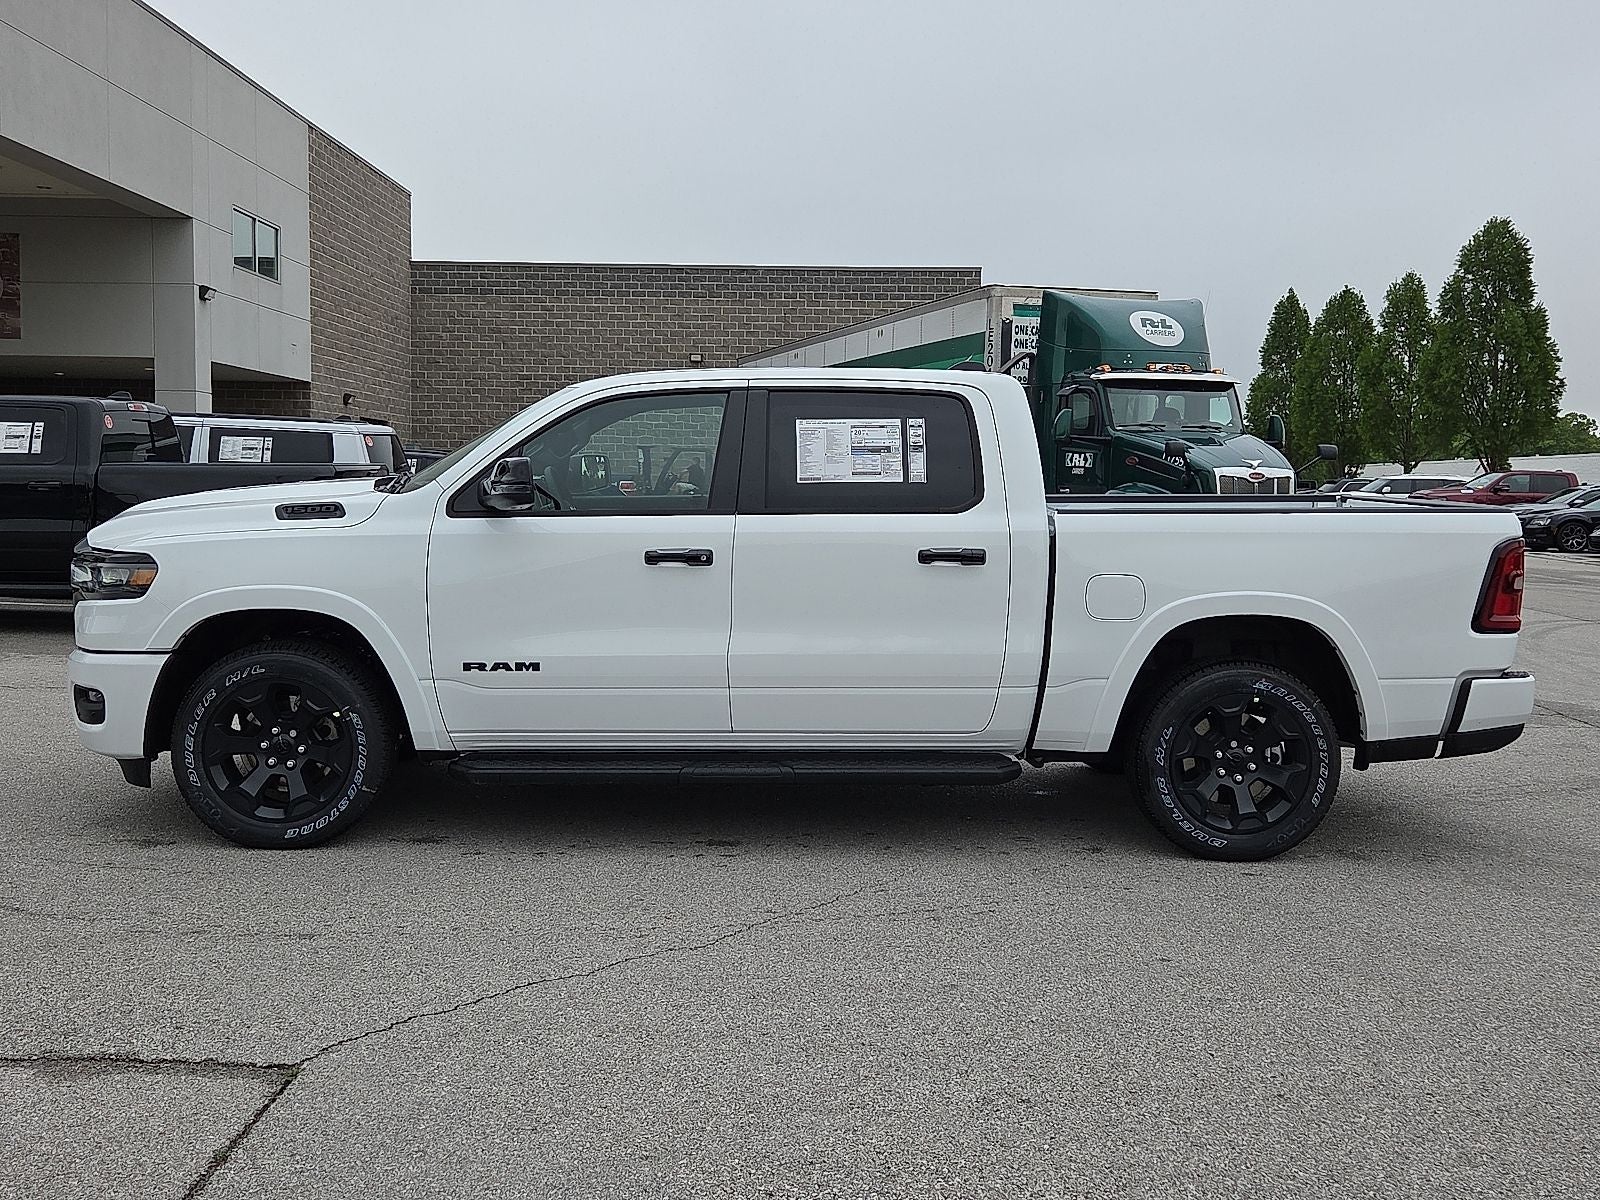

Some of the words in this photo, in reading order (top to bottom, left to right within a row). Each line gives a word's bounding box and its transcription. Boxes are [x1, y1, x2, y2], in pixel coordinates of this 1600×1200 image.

[987, 319, 995, 372] LE20
[1013, 338, 1029, 349] ONE
[1014, 325, 1029, 336] ONE
[1145, 329, 1176, 337] CARRIERS
[283, 505, 335, 513] 1500
[462, 661, 541, 672] RAM
[184, 688, 217, 787] DUELER
[1252, 679, 1329, 808] BRIDGESTONE
[284, 708, 367, 839] BRIDGESTONE
[1156, 776, 1228, 848] DUELER
